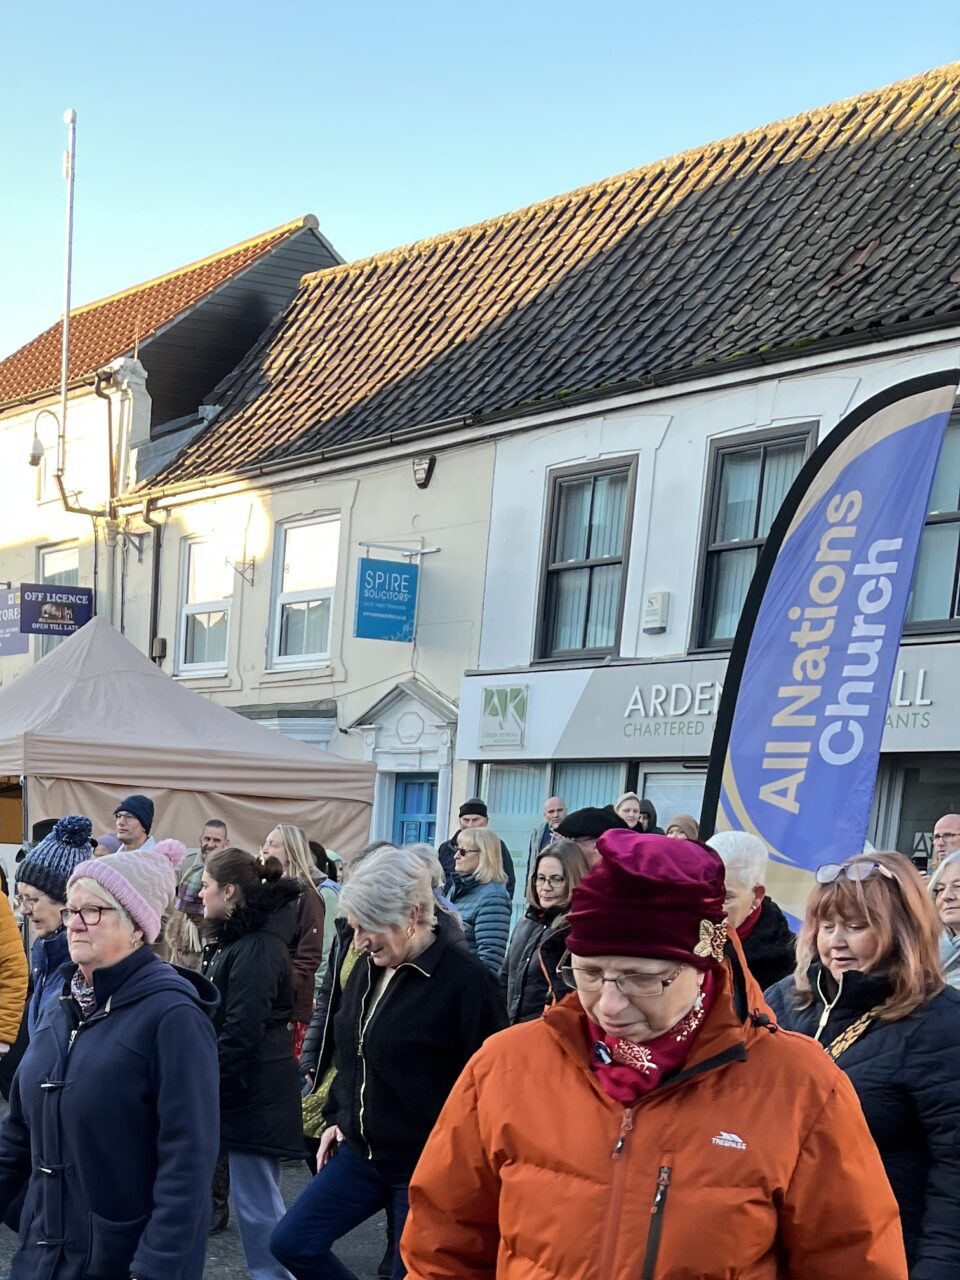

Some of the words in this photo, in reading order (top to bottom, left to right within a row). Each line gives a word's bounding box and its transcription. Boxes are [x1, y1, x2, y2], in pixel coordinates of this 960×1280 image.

[365, 570, 410, 592] SPIRE
[24, 591, 45, 601] OFF
[46, 592, 89, 604] LICENCE
[31, 622, 49, 630] OPEN
[49, 622, 64, 631] TILL
[818, 537, 904, 766] Church
[623, 721, 705, 737] CHARTERED
[711, 1137, 747, 1150] TRESPASS
